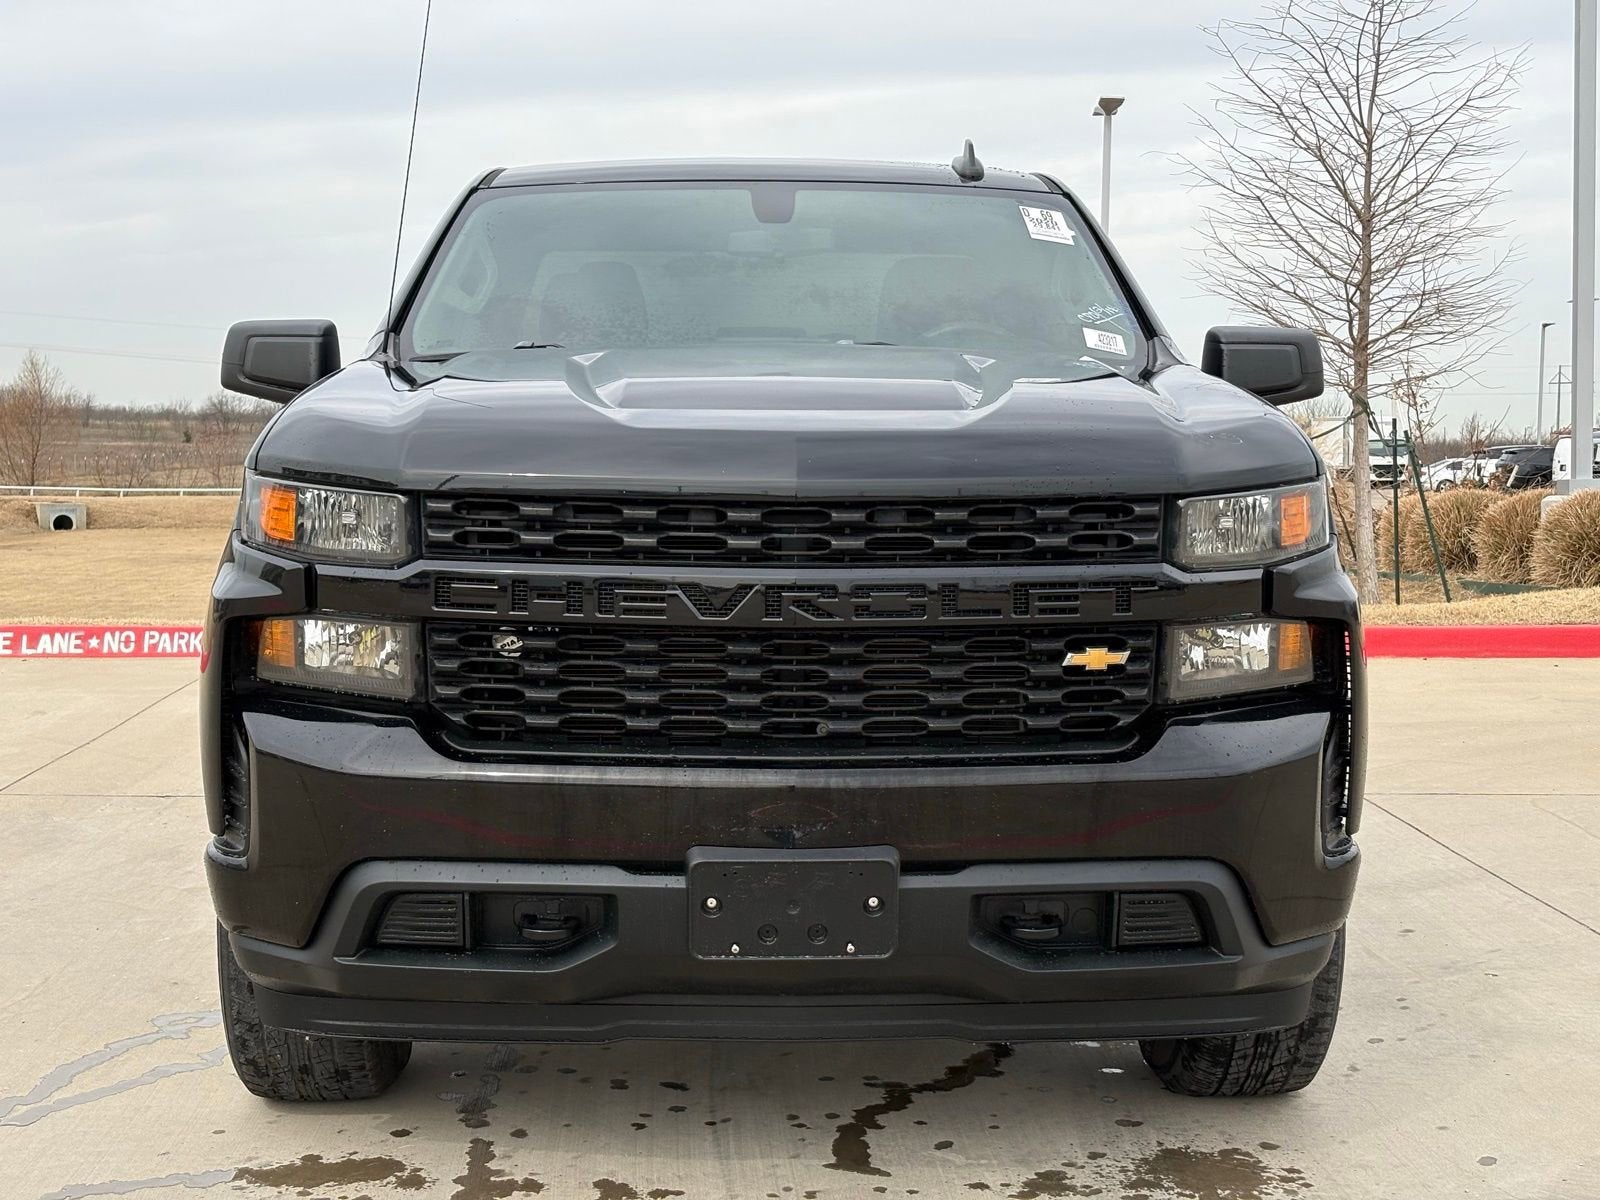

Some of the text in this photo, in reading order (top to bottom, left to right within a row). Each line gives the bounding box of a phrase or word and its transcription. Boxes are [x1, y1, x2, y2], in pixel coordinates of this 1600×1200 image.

[1040, 210, 1053, 221] 69
[432, 579, 1158, 620] CHEVROLET
[21, 631, 85, 654] LANE
[102, 630, 136, 653] NO
